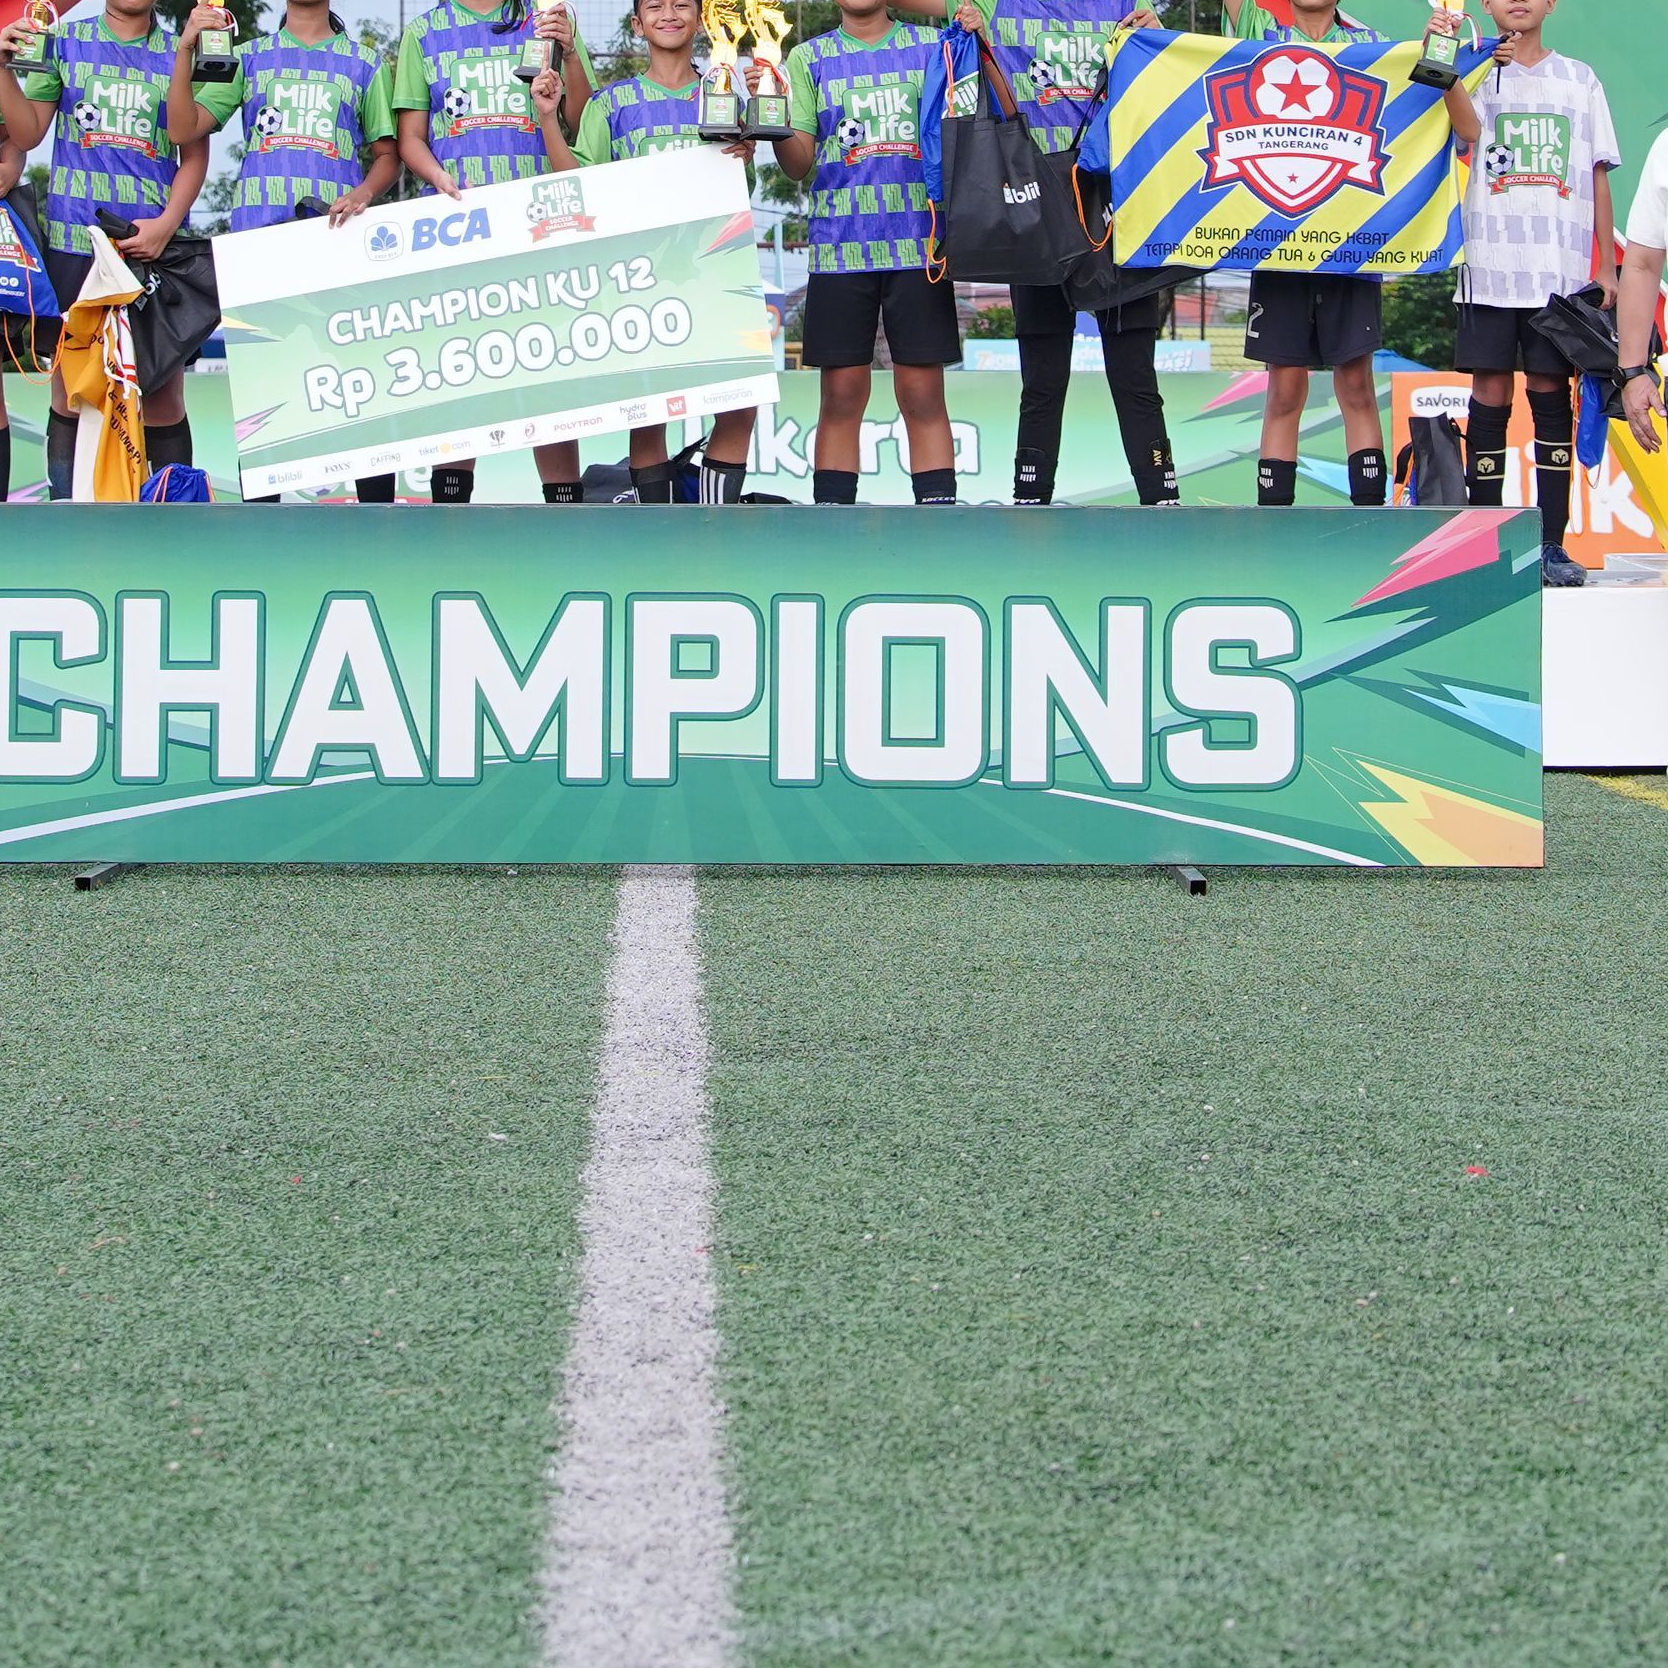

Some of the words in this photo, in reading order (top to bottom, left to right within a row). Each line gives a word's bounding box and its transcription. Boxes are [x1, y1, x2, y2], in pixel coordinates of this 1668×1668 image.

[1044, 35, 1105, 64] Milk
[458, 58, 523, 87] Milk
[92, 81, 152, 113] Milk
[274, 83, 333, 112] Milk
[471, 85, 526, 114] Life
[851, 88, 914, 118] Milk
[101, 107, 152, 138] Life
[282, 109, 334, 137] Life
[460, 117, 485, 127] SOCCER
[486, 116, 524, 126] CHALLENGE
[865, 114, 916, 143] Life
[1225, 128, 1257, 144] SDN
[1263, 126, 1348, 143] KUNCIRAN
[1354, 134, 1363, 146] 4
[1503, 117, 1563, 148] Milk
[90, 134, 113, 142] SOCCER
[114, 135, 148, 149] CHALLENGE
[269, 136, 293, 147] SOCCER
[294, 137, 330, 150] CHALLENGE
[855, 145, 878, 156] SOCCER
[878, 143, 914, 153] CHALLENGE
[1258, 141, 1329, 151] TANGERANG
[1515, 145, 1564, 175] Life
[538, 180, 579, 202] Milk
[1504, 176, 1529, 184] SOCCER
[547, 196, 583, 217] Life
[411, 207, 492, 252] BCA
[1195, 226, 1240, 240] BUKAN
[1245, 228, 1296, 242] PEMAIN
[1301, 230, 1341, 244] YANG
[1346, 231, 1390, 245] HEBAT
[1145, 243, 1183, 257] TETAPI
[1186, 245, 1214, 258] DOA
[1218, 246, 1272, 261] ORANG
[1277, 248, 1303, 262] TUA
[1321, 249, 1362, 263] GURU
[1367, 249, 1406, 263] YANG
[1410, 248, 1444, 263] KUAT
[328, 277, 540, 346] CHAMPION
[545, 264, 601, 310] KU
[608, 255, 657, 293] 12
[1247, 302, 1265, 338] 2
[304, 364, 375, 417] Rp
[385, 297, 691, 396] 3.600.000
[1416, 392, 1468, 408] SAVORI
